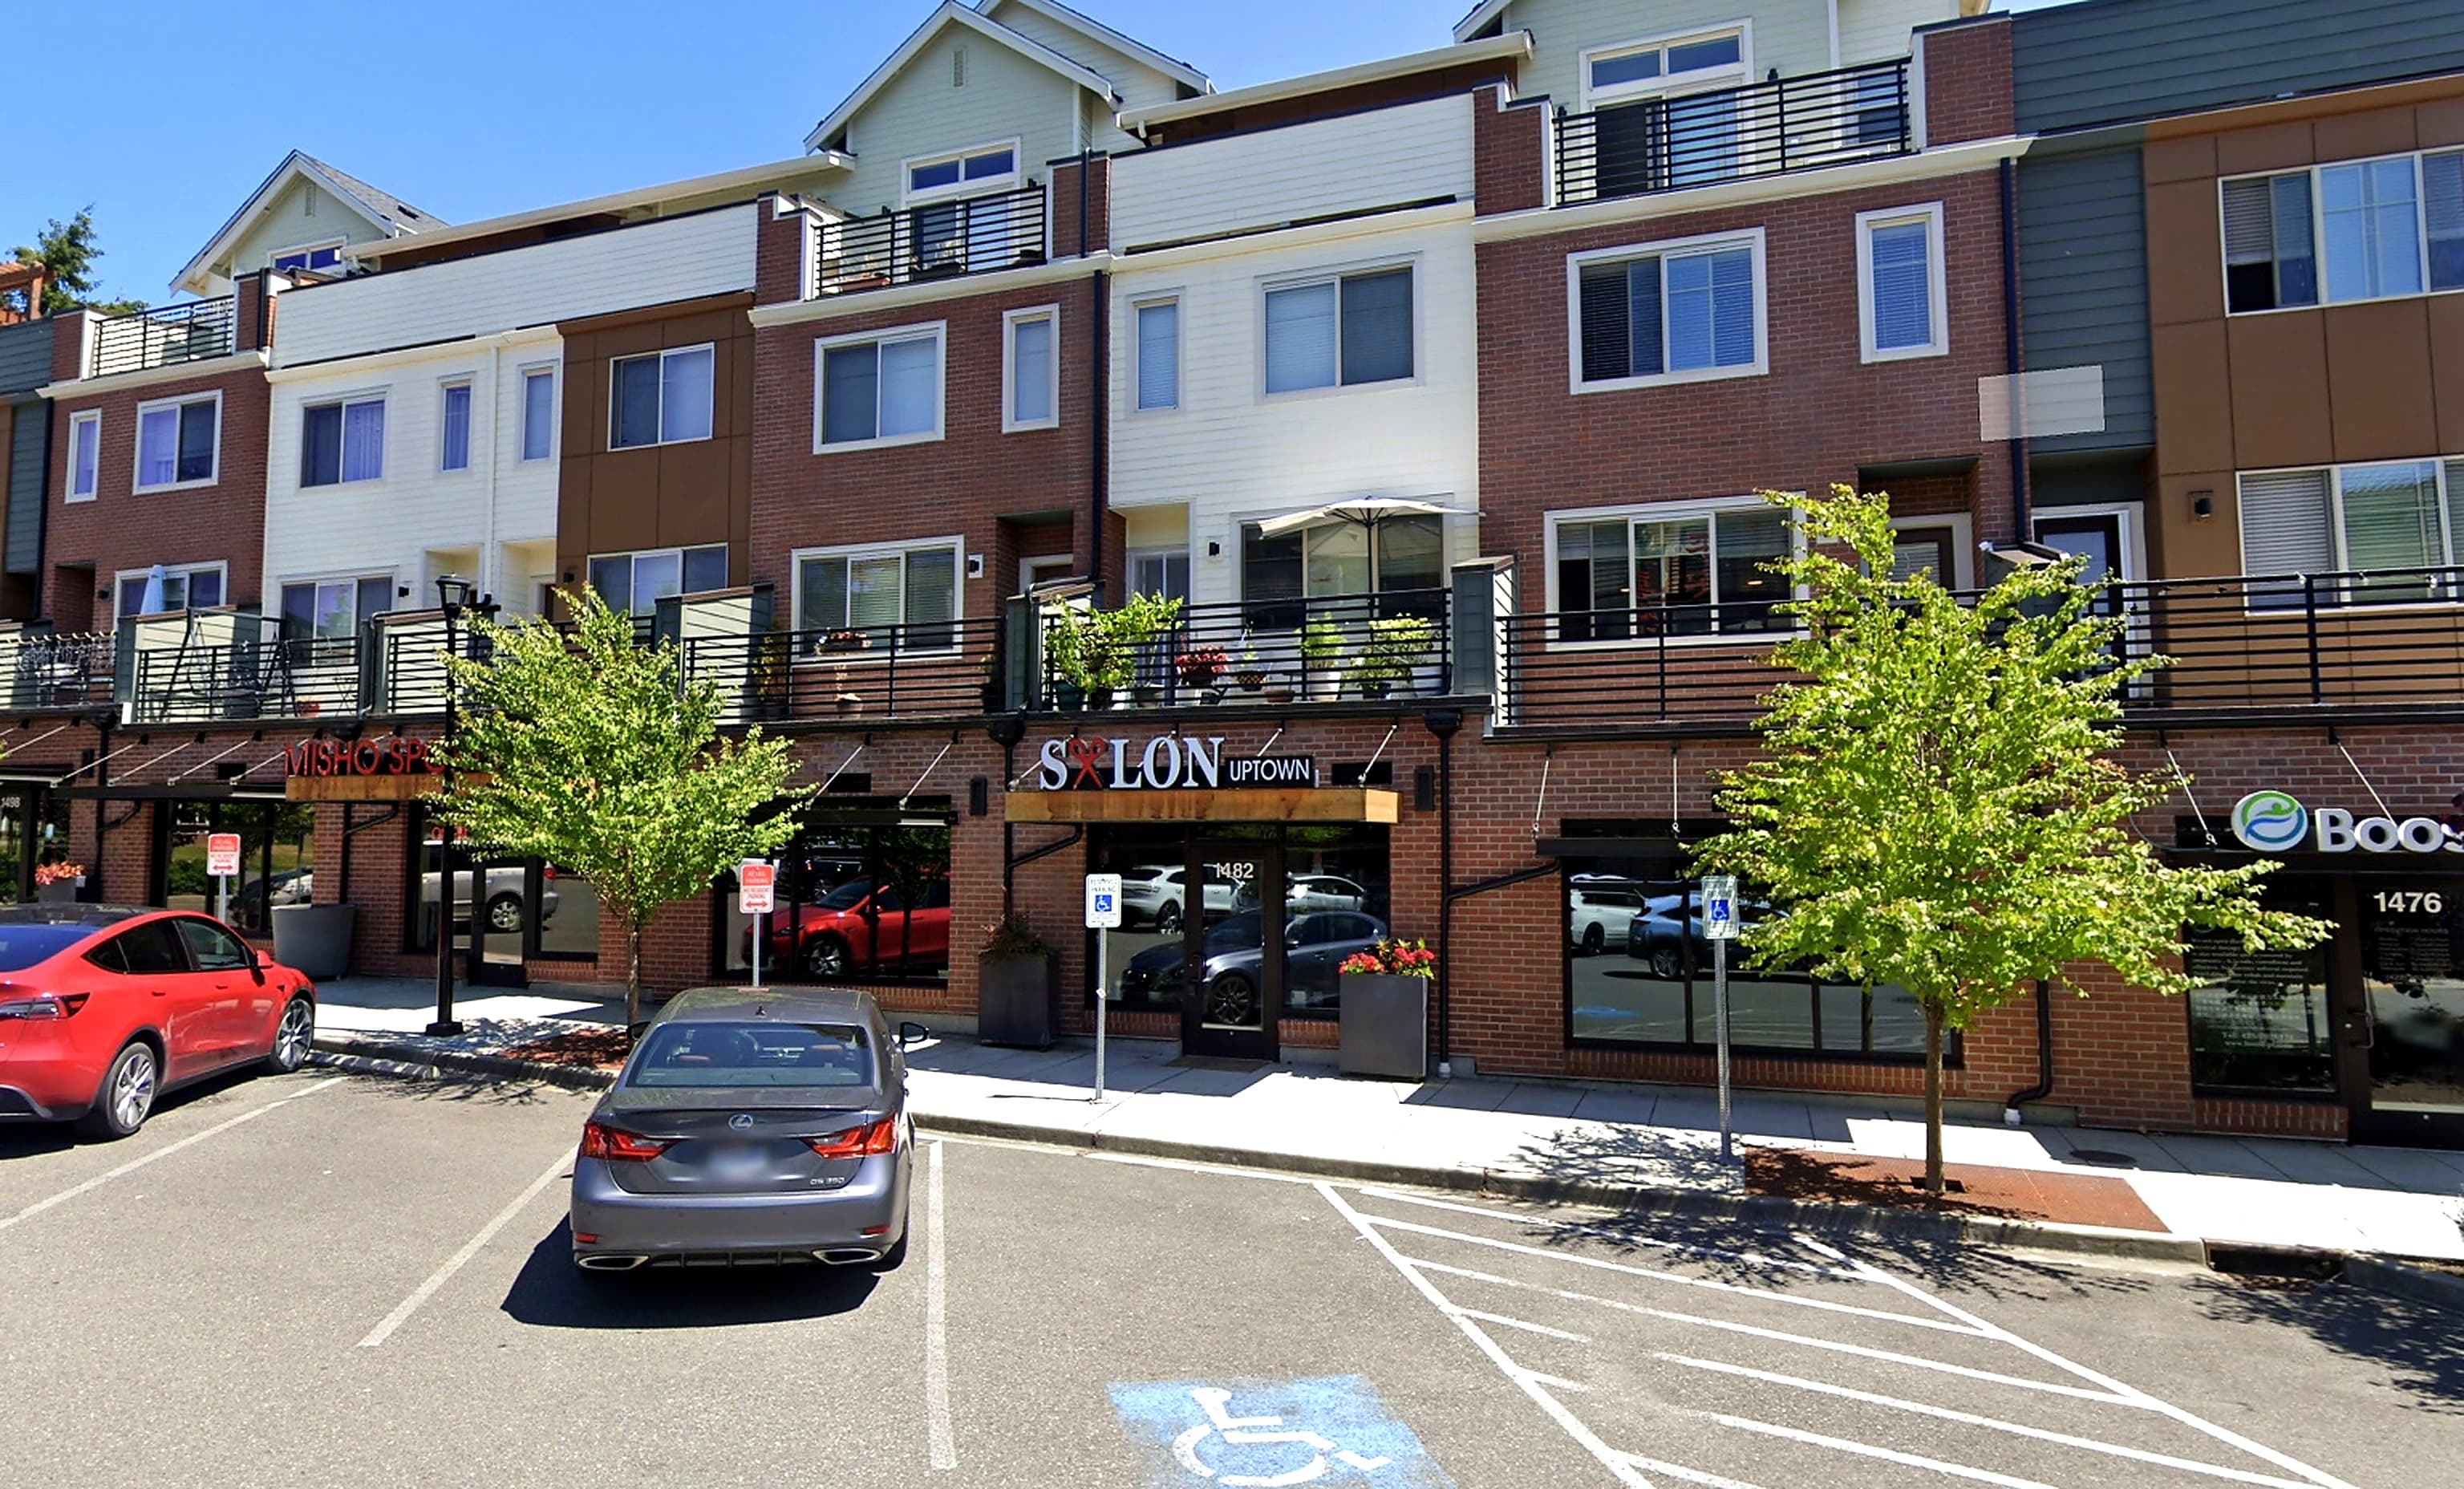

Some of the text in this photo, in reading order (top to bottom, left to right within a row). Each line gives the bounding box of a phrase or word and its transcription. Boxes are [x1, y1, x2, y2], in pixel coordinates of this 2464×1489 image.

[285, 740, 380, 776] MISHO
[1230, 758, 1310, 781] UPTOWN
[1213, 862, 1254, 878] 1482
[2373, 891, 2442, 913] 1476
